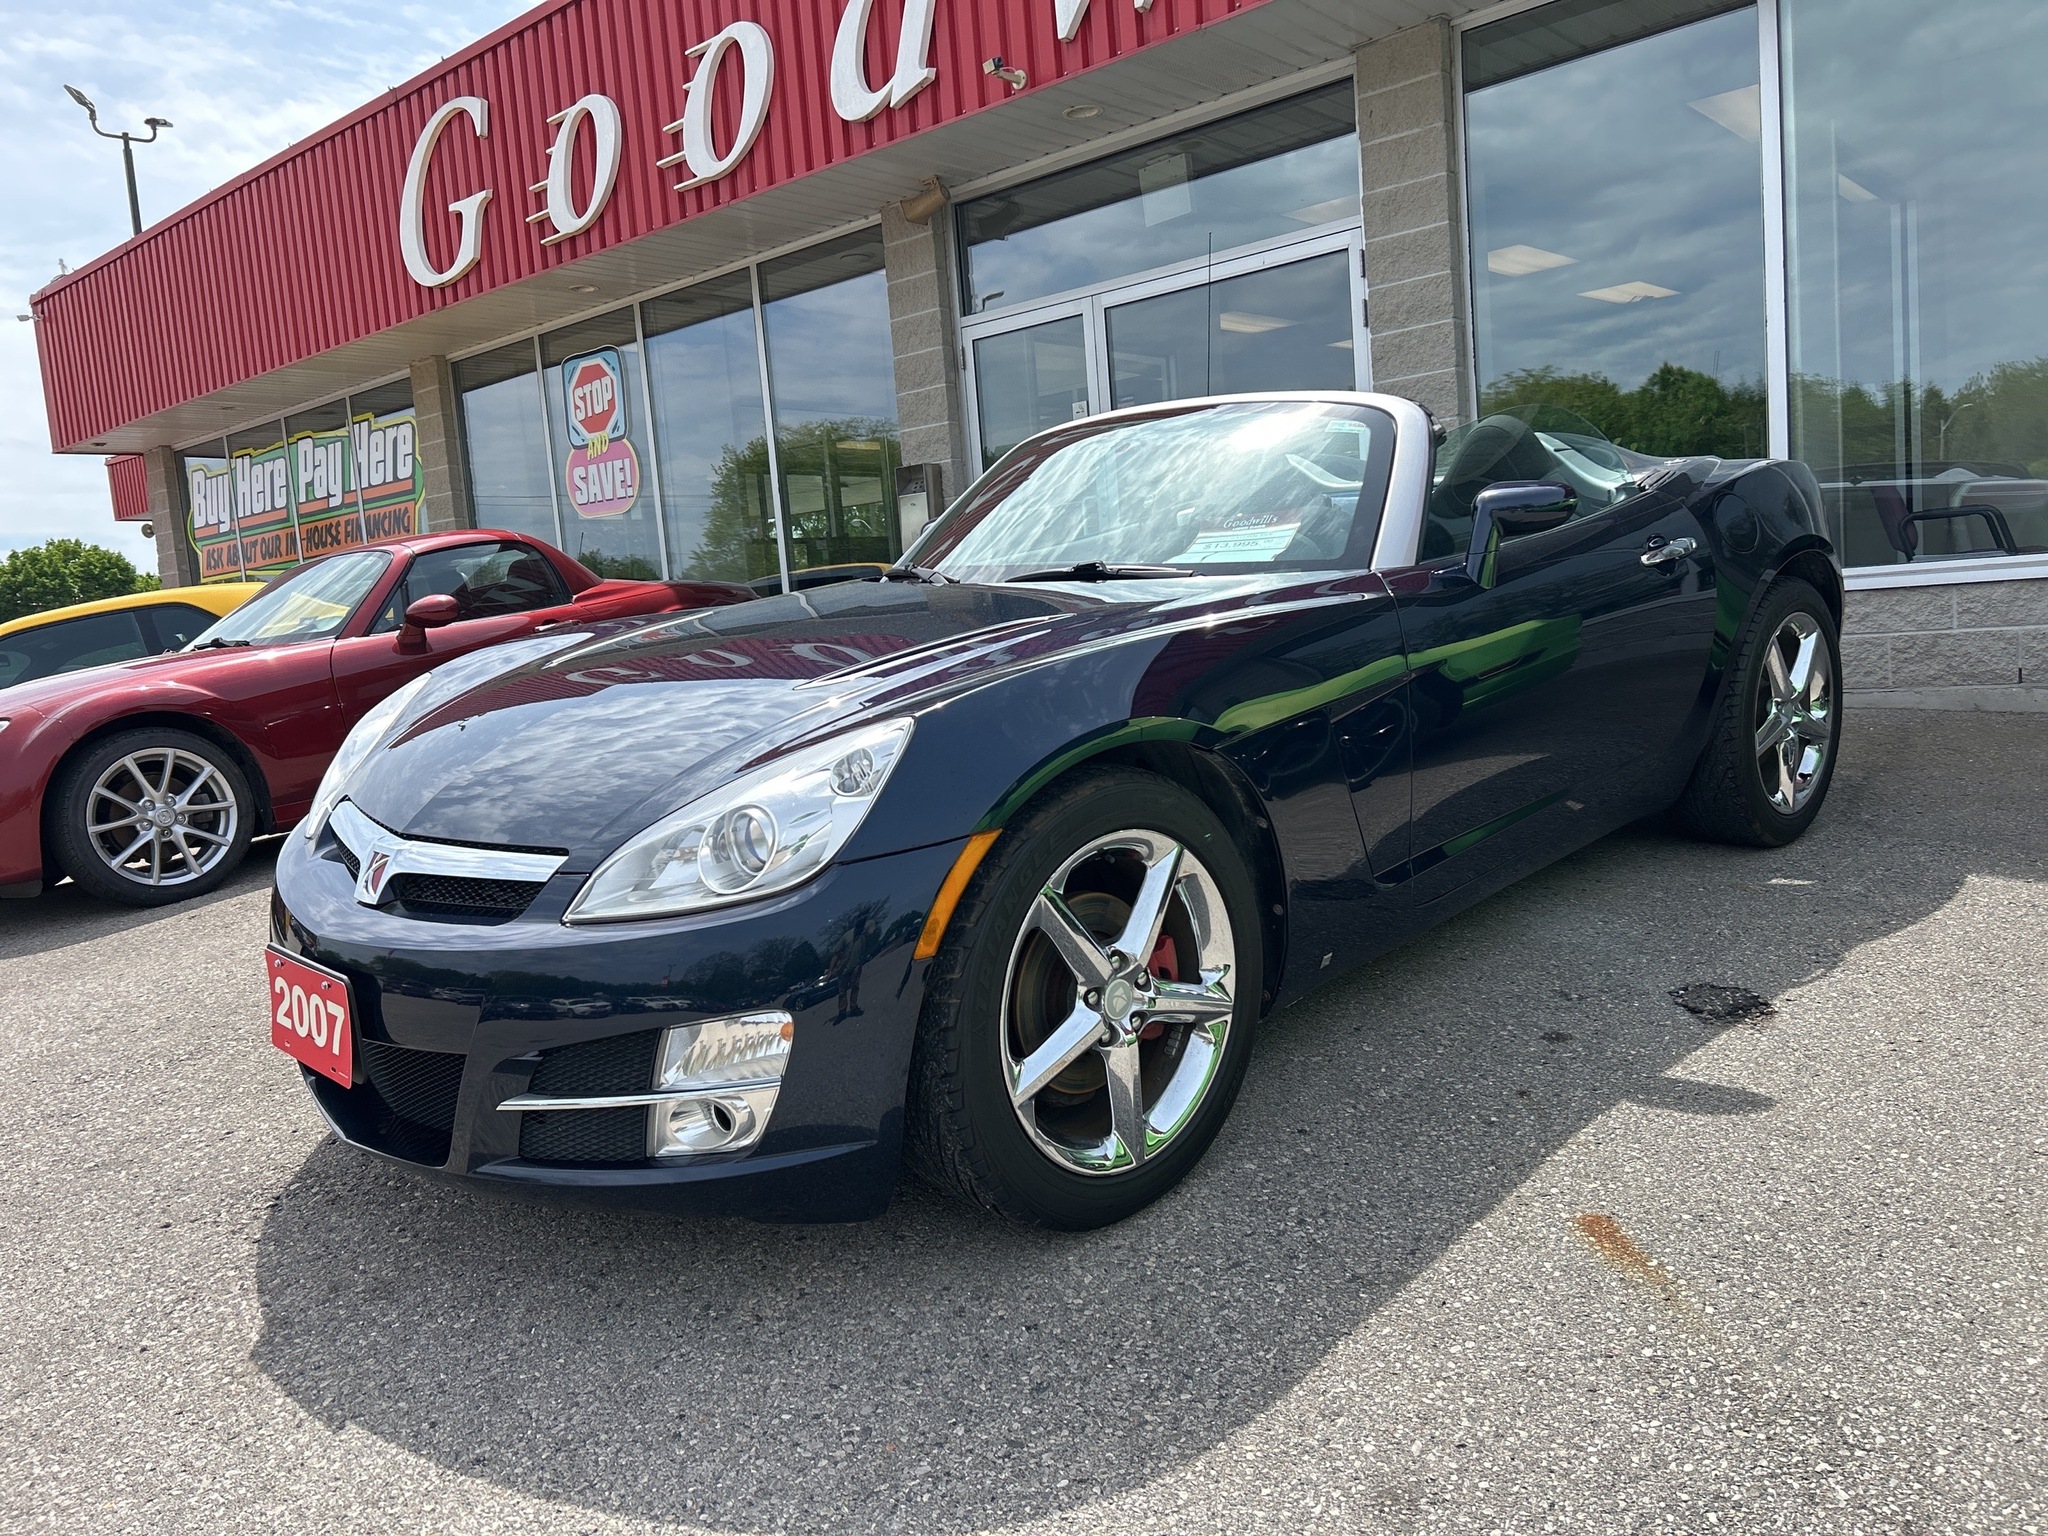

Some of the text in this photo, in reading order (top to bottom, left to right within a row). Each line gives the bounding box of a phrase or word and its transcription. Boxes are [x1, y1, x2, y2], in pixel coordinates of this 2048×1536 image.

[399, 0, 1152, 287] Goo
[574, 377, 613, 422] STOP
[587, 431, 609, 461] AND
[192, 420, 414, 533] Buy Here Pay Here
[572, 458, 634, 505] SAVE!
[206, 547, 224, 571] ASK
[260, 533, 282, 561] OUR
[285, 520, 342, 557] IN-HOUSE
[344, 506, 411, 543] FINANCING
[1223, 514, 1279, 528] Goodwill's
[274, 976, 345, 1056] 2007
